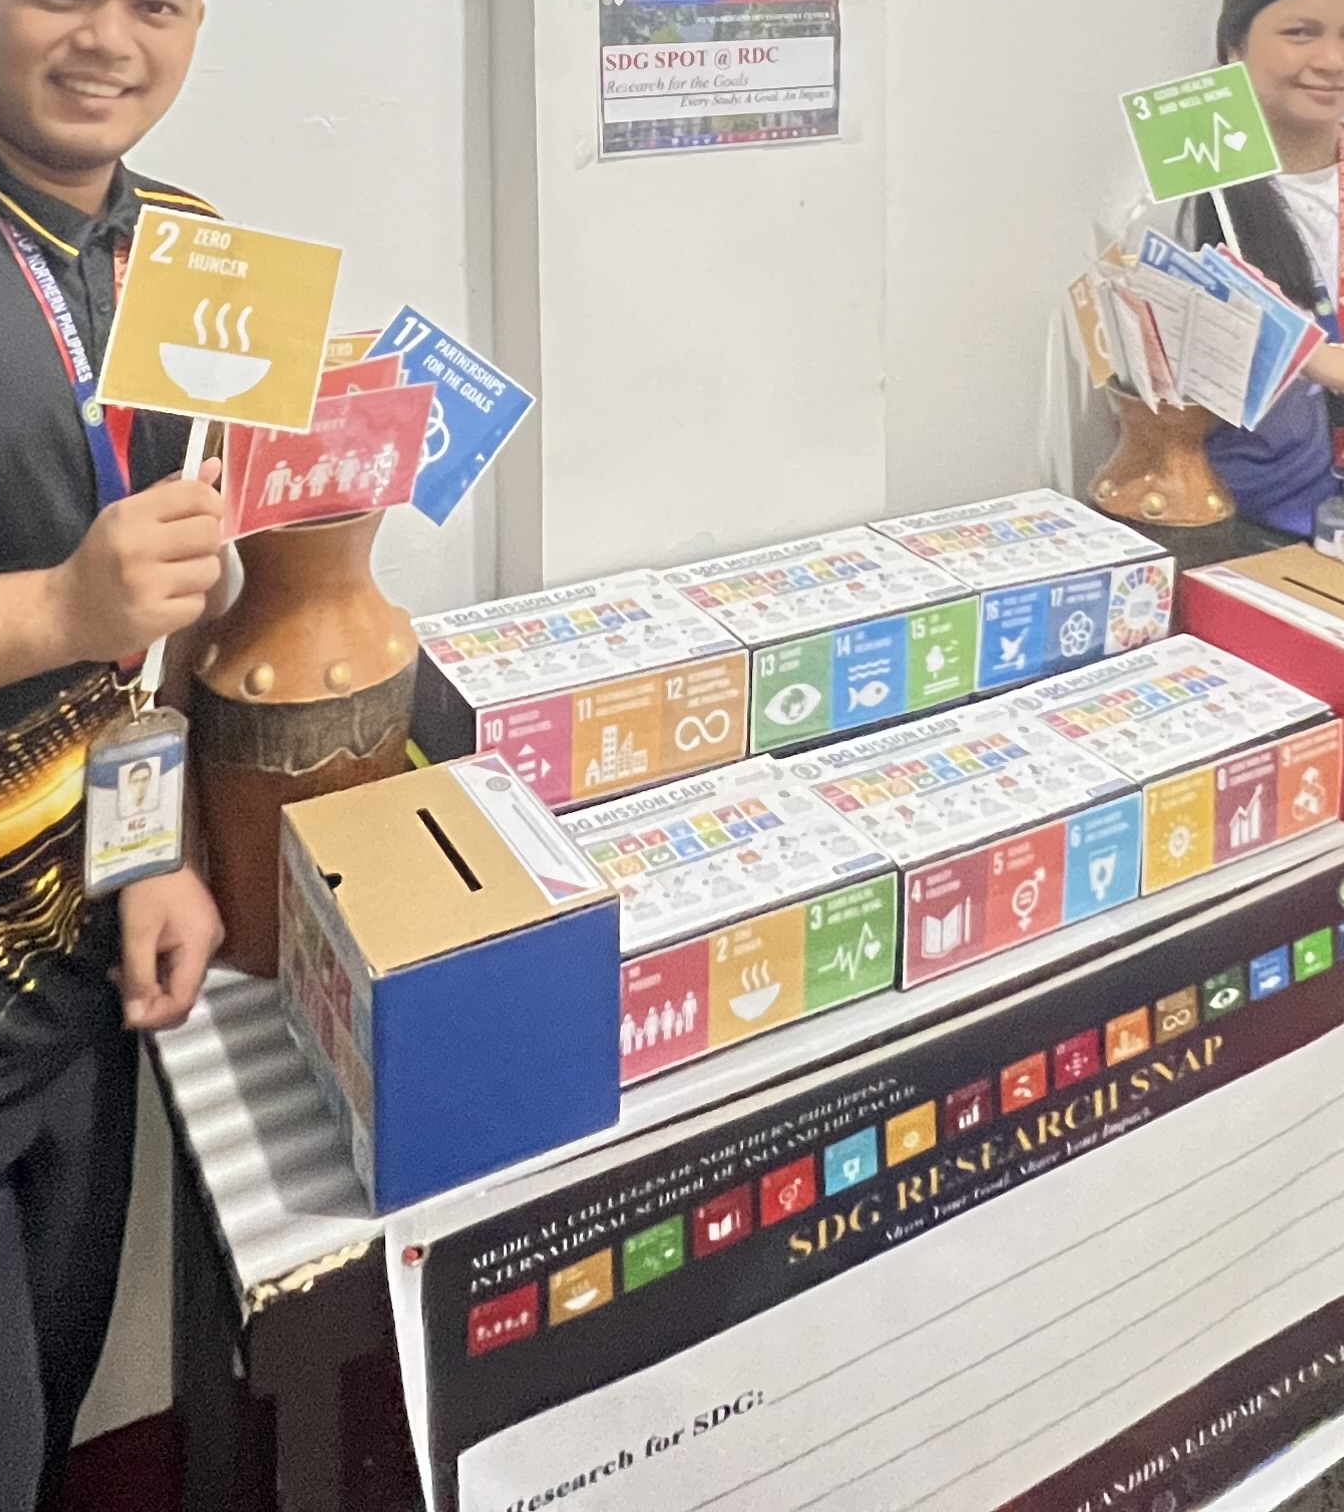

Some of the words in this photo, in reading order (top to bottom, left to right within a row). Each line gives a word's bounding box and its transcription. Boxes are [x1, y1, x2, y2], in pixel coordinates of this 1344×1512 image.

[605, 52, 649, 71] SDG
[655, 49, 708, 69] SPOT
[714, 48, 732, 70] @
[738, 46, 780, 65] RDC
[606, 79, 664, 95] Research
[667, 77, 687, 92] for
[689, 75, 710, 89] the
[713, 73, 749, 88] Goals
[680, 96, 710, 108] Every
[1132, 95, 1152, 120] 3
[149, 222, 180, 264] 2
[192, 227, 232, 250] ZERO
[1146, 237, 1169, 266] 17
[188, 252, 249, 279] HUNGER
[27, 253, 67, 314] NORTHERN
[55, 312, 93, 383] PHILIPPINES
[392, 316, 431, 353] 17
[434, 337, 508, 397] PARTNERSHIPS
[422, 354, 447, 377] FOR
[440, 367, 465, 391] THE
[460, 382, 496, 414] GOALS
[443, 609, 483, 626] SDG
[484, 595, 552, 617] MISSION
[553, 584, 596, 604] CARD
[985, 600, 1000, 621] 16
[1050, 587, 1064, 608] 17
[910, 618, 926, 640] 15
[836, 635, 851, 657] 14
[760, 654, 775, 678] 13
[665, 676, 684, 701] 12
[576, 698, 592, 722] 11
[483, 718, 504, 743] 10
[817, 749, 855, 766] SDG
[853, 729, 916, 755] MISSION
[917, 717, 959, 736] CARD
[563, 818, 593, 834] DG
[594, 794, 668, 826] MISSION
[668, 780, 716, 802] CARD
[1070, 824, 1082, 848] 6
[992, 851, 1004, 875] 5
[911, 879, 922, 903] 4
[810, 904, 824, 931] 3
[715, 936, 728, 963] 2
[788, 1193, 881, 1264] SDG
[897, 1080, 1119, 1211] RESEARCH
[1129, 1035, 1223, 1100] SNAP
[472, 1220, 557, 1269] MEDICAL
[567, 1177, 666, 1228] COLLEGES
[699, 1121, 794, 1165] NORTHERN
[798, 1078, 897, 1125] PHILIPPINES
[471, 1213, 626, 1293] INTERNATIONAL
[636, 1176, 704, 1214] SCHOOL
[713, 1165, 734, 1181] OF
[743, 1144, 779, 1168] ASIA
[786, 1126, 819, 1148] AND
[824, 1112, 853, 1132] THE
[858, 1085, 916, 1117] PACIFIC
[645, 1427, 686, 1459] for
[693, 1390, 763, 1437] SDG:
